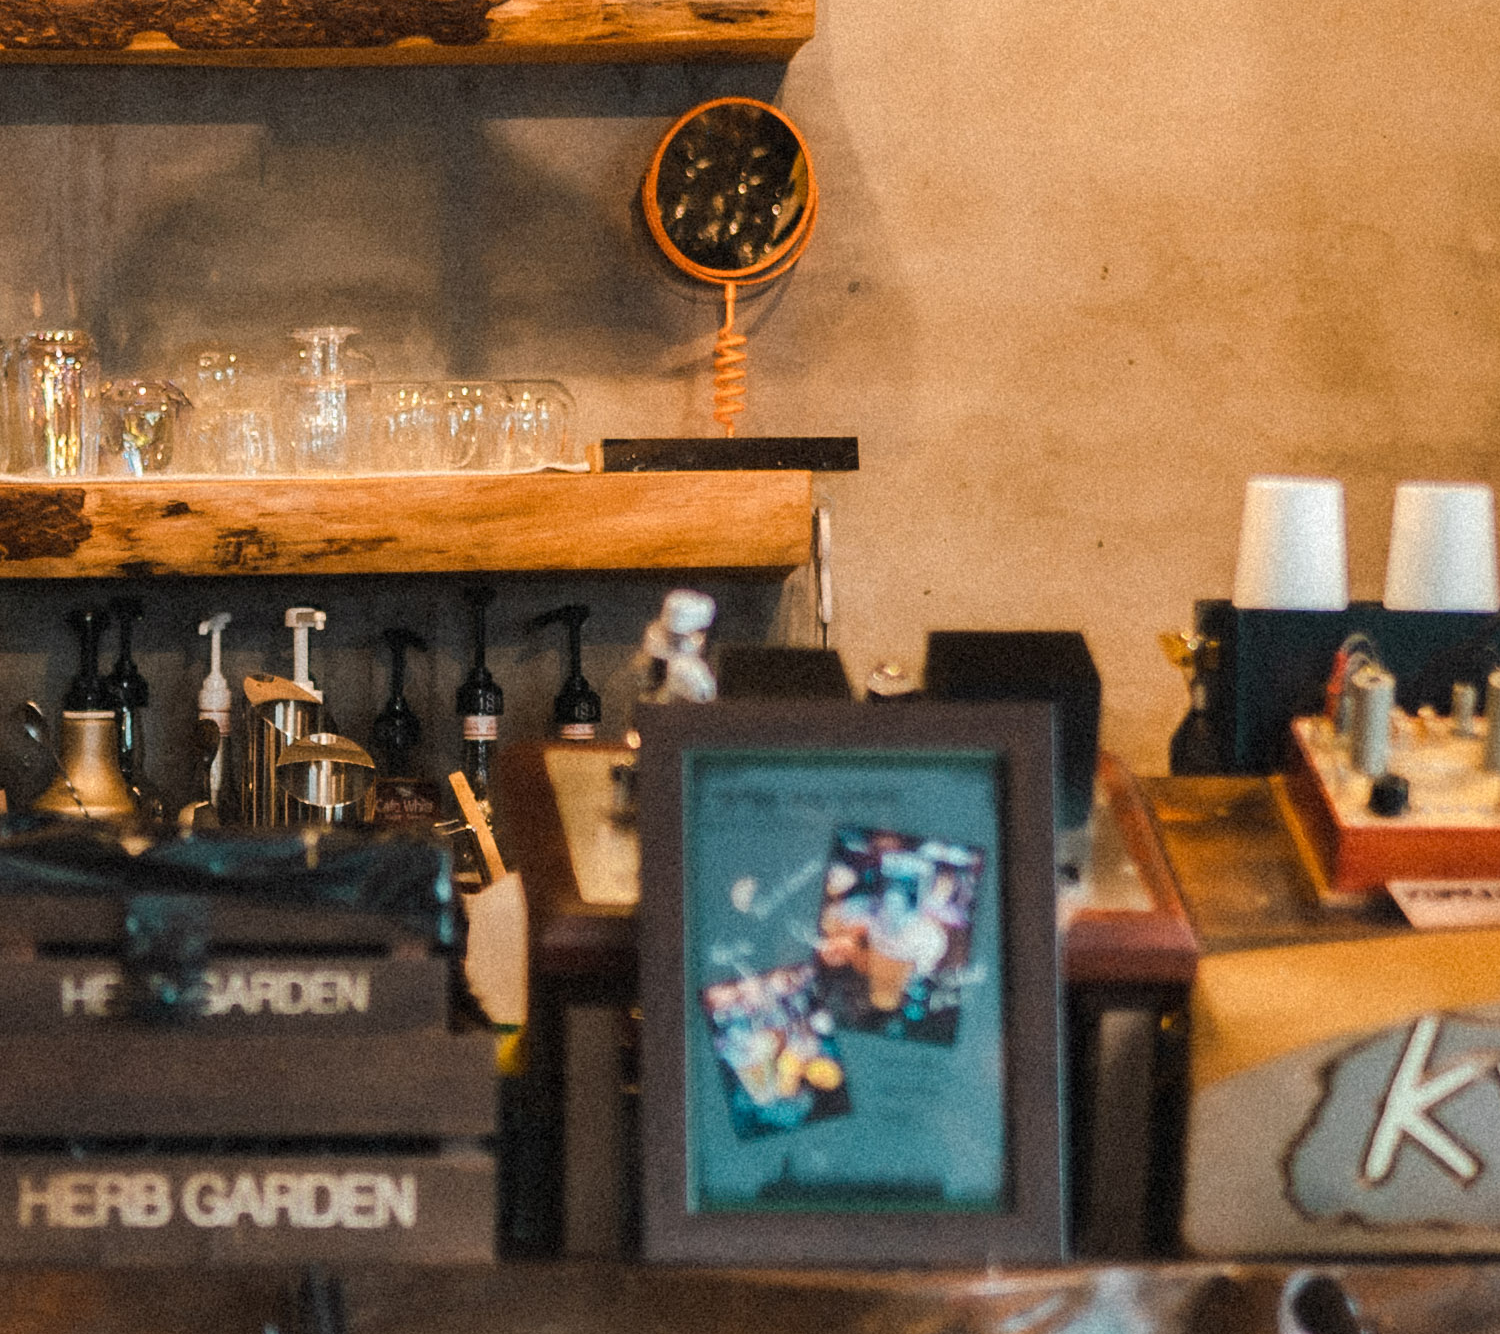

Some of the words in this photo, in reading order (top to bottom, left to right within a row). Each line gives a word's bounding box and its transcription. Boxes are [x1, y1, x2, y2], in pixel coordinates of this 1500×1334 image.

[200, 971, 372, 1017] GARDEN
[16, 1172, 173, 1229] HERB
[181, 1172, 419, 1229] GARDEN
